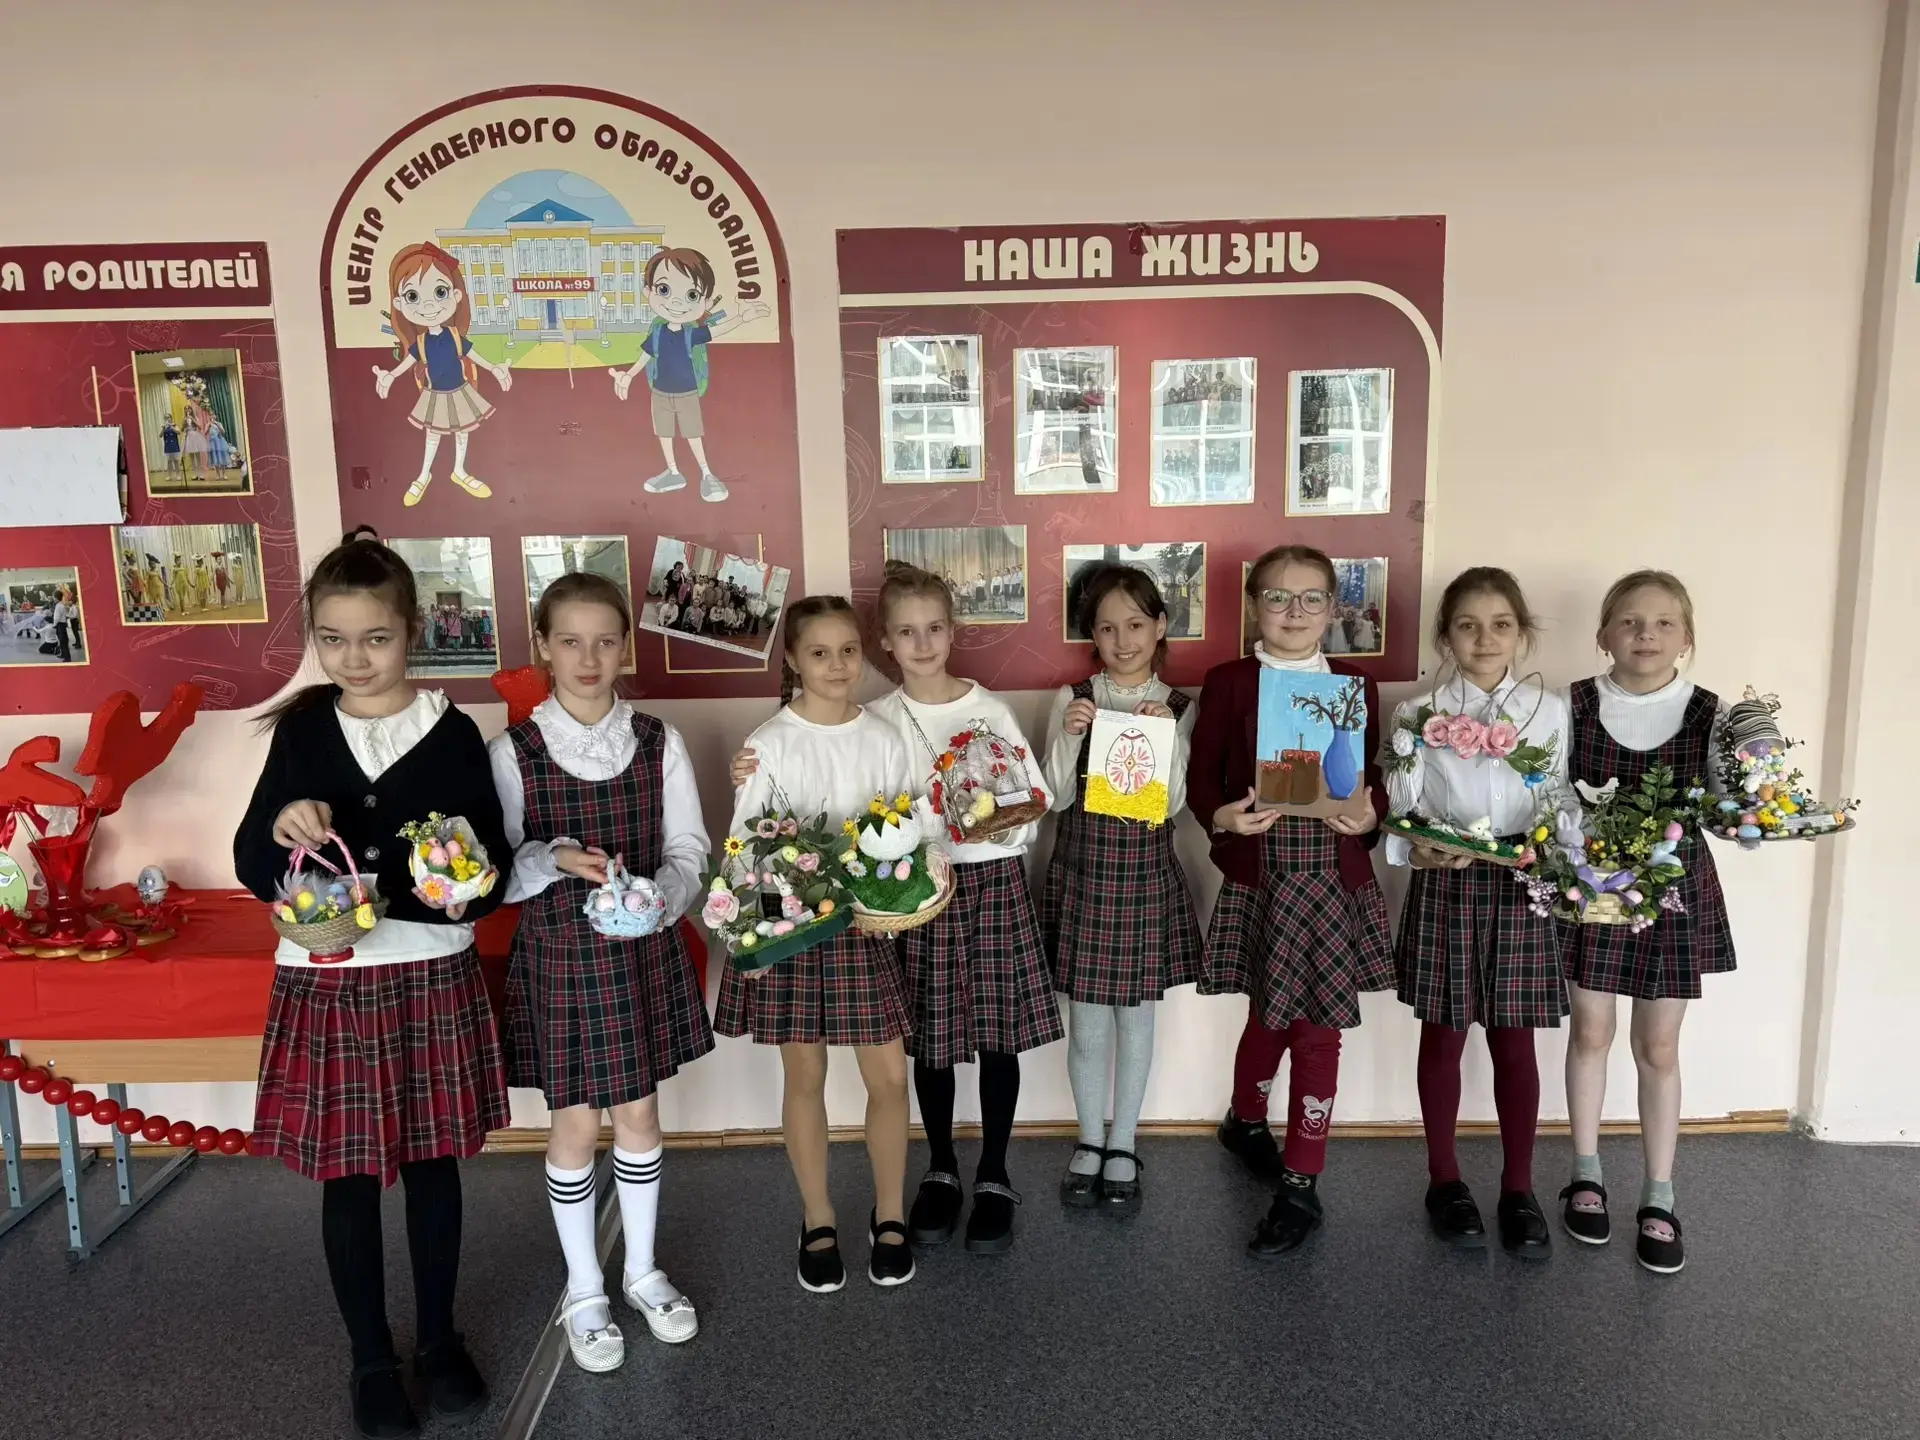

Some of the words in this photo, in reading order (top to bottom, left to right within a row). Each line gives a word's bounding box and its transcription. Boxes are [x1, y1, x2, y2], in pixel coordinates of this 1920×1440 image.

[347, 206, 387, 305] ЦЕНТР
[383, 117, 576, 203] ГЕНДЕРНОГО
[593, 123, 761, 300] ОБРАЗОВАНИЯ
[43, 252, 259, 291] РОДИТЕЛЕЙ
[963, 235, 1113, 282] НАША
[1140, 231, 1320, 277] ЖИЗНЬ
[516, 280, 563, 290] ШКОЛА
